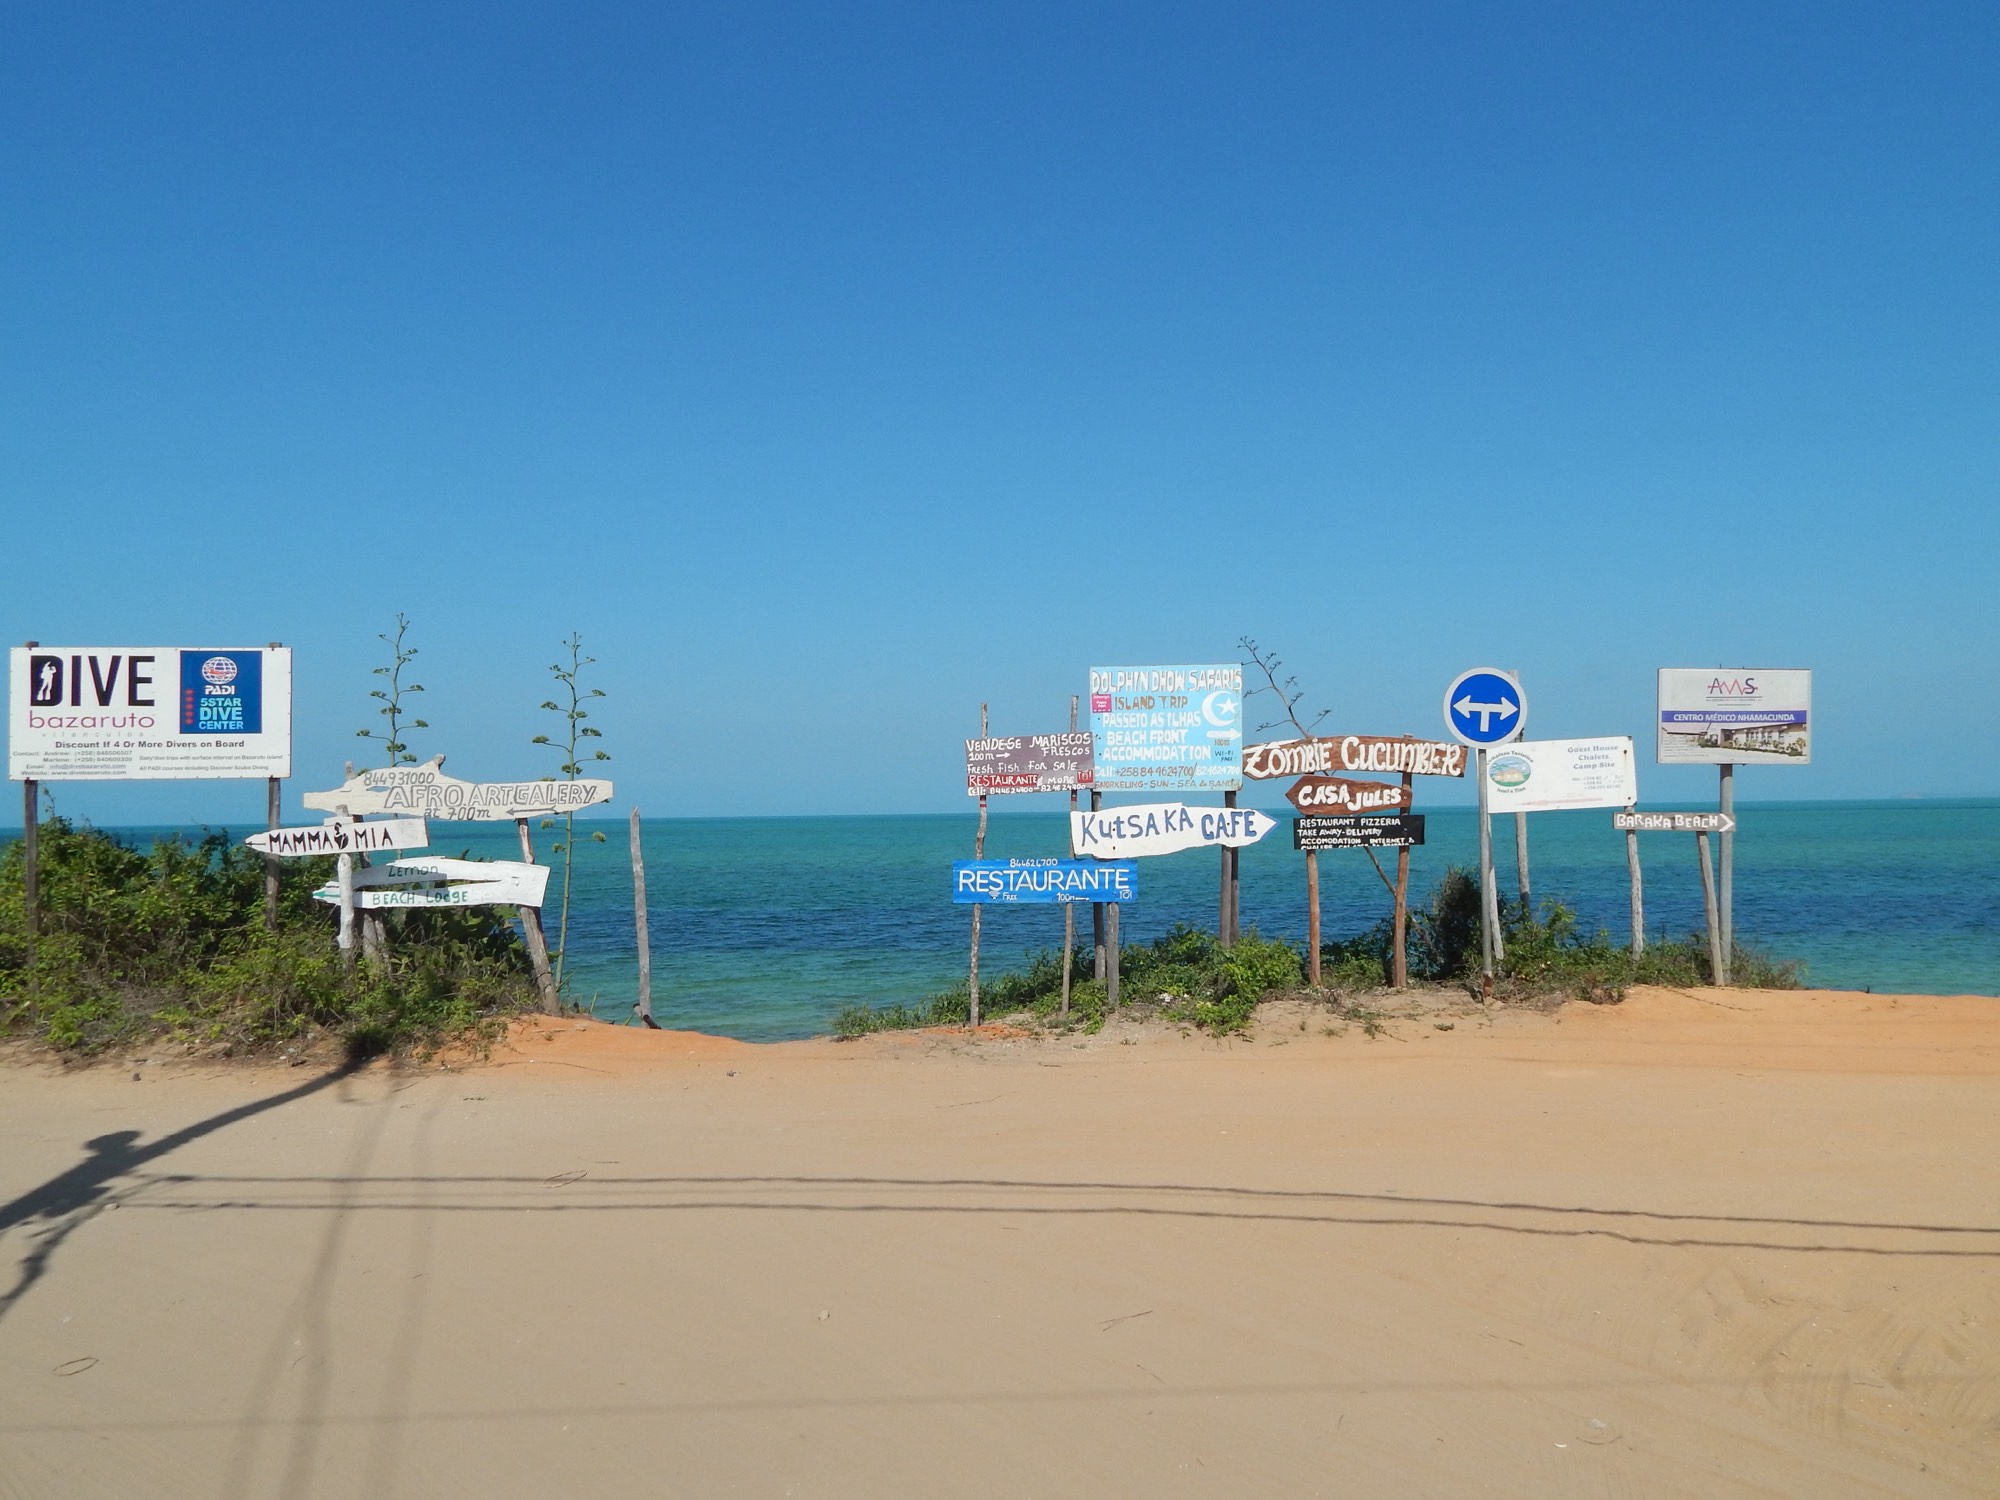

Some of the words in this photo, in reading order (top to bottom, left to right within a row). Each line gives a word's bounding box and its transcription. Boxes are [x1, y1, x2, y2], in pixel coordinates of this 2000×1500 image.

[30, 655, 155, 706] DIVE
[1091, 670, 1149, 693] DOLPHIN
[1151, 670, 1185, 692] DHOW
[1188, 669, 1242, 691] SAFARIS
[204, 685, 236, 695] PADI
[1114, 695, 1155, 711] ISLAND
[29, 710, 155, 728] bazaruto
[200, 706, 243, 721] DIVE
[1150, 713, 1164, 727] AS
[1673, 713, 1704, 721] CENTRO
[1705, 711, 1737, 721] MÉDICO
[1737, 713, 1795, 721] NHAMACUNDA
[198, 720, 244, 730] CENTER
[166, 740, 197, 748] Divers
[215, 740, 245, 748] Board
[1106, 731, 1147, 746] BEACH
[1149, 729, 1189, 745] FRONT
[1041, 746, 1090, 757] FRESCOS
[1102, 745, 1212, 762] ACCOMMODATION
[1243, 739, 1333, 779] ZOMBIE
[1341, 736, 1462, 776] CUCUMBER
[364, 772, 436, 786] 844931000
[969, 773, 1037, 787] RESTAURANTE
[1149, 779, 1169, 789] SUN
[1298, 784, 1350, 807] CASA
[1346, 788, 1402, 812] JULES
[1200, 810, 1258, 840] CAFE
[1299, 817, 1356, 828] RESTAURANT
[1360, 817, 1402, 826] PIZZERIA
[1616, 814, 1672, 828] BARAKA
[1674, 814, 1719, 828] BEACH
[269, 830, 333, 852] MAMMA
[354, 827, 393, 848] MIA
[958, 869, 1130, 893] RESTAURANTE
[372, 892, 415, 905] BEACH
